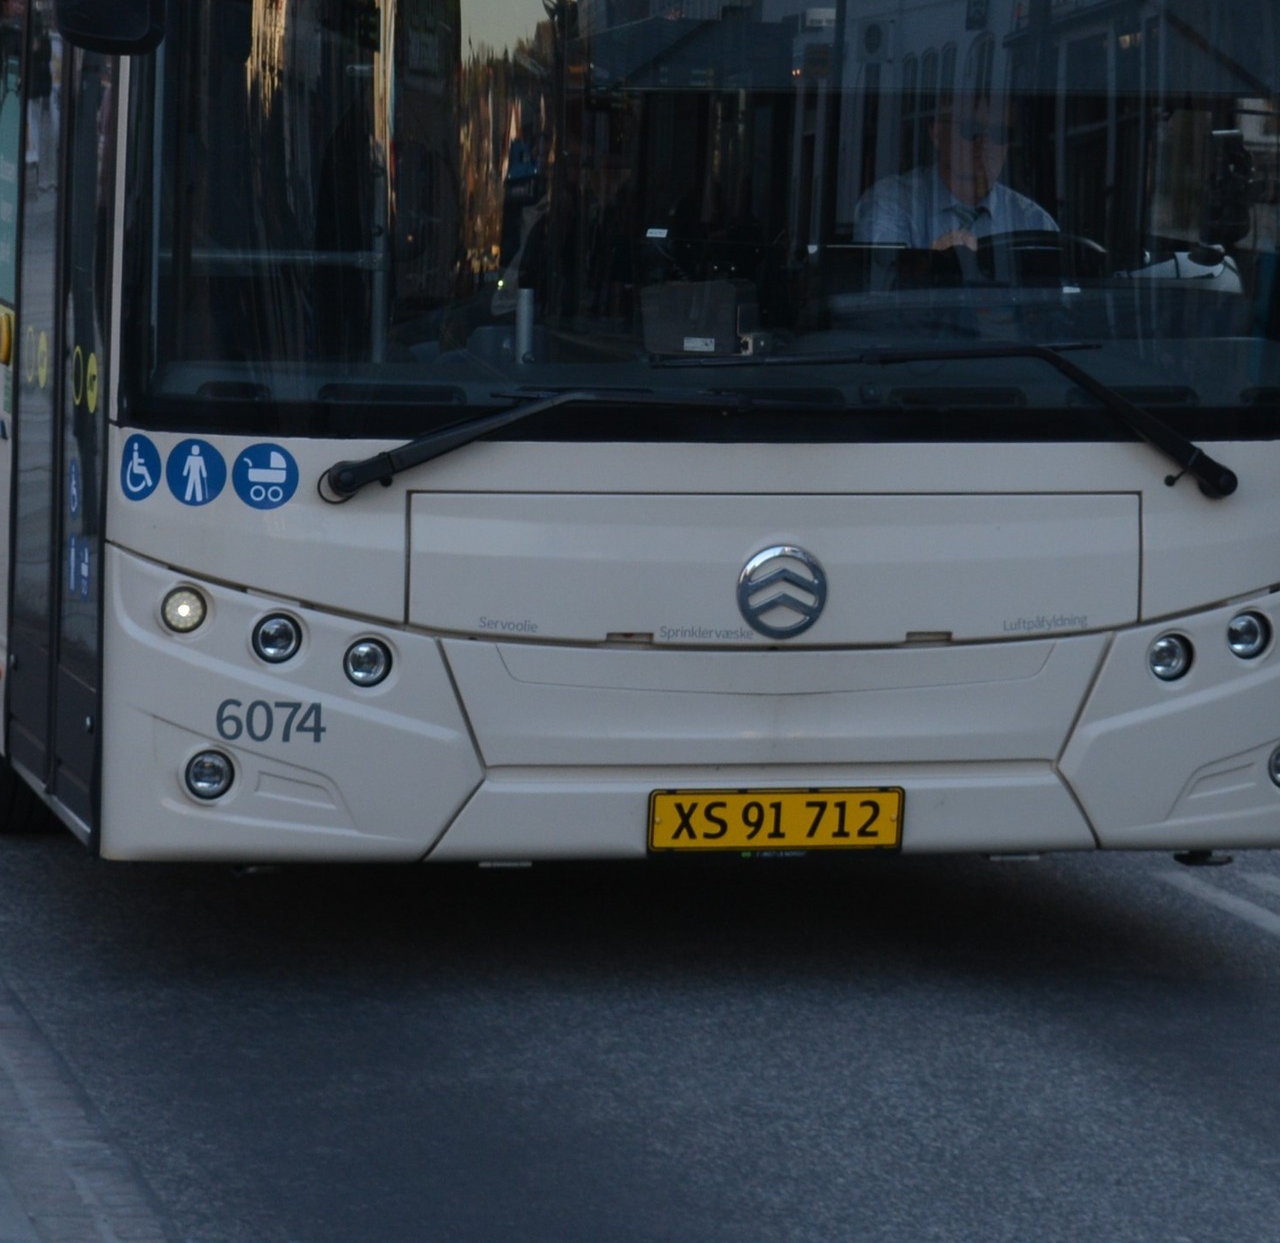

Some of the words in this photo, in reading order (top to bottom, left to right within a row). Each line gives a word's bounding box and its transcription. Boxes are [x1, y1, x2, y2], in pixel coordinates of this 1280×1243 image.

[478, 615, 539, 634] Servoolie
[659, 624, 754, 642] Sprinklervæske
[1002, 613, 1088, 634] Luftpåfyldning
[215, 698, 327, 744] 6074
[671, 801, 728, 840] XS
[741, 801, 786, 840] 91
[805, 800, 881, 838] 712
